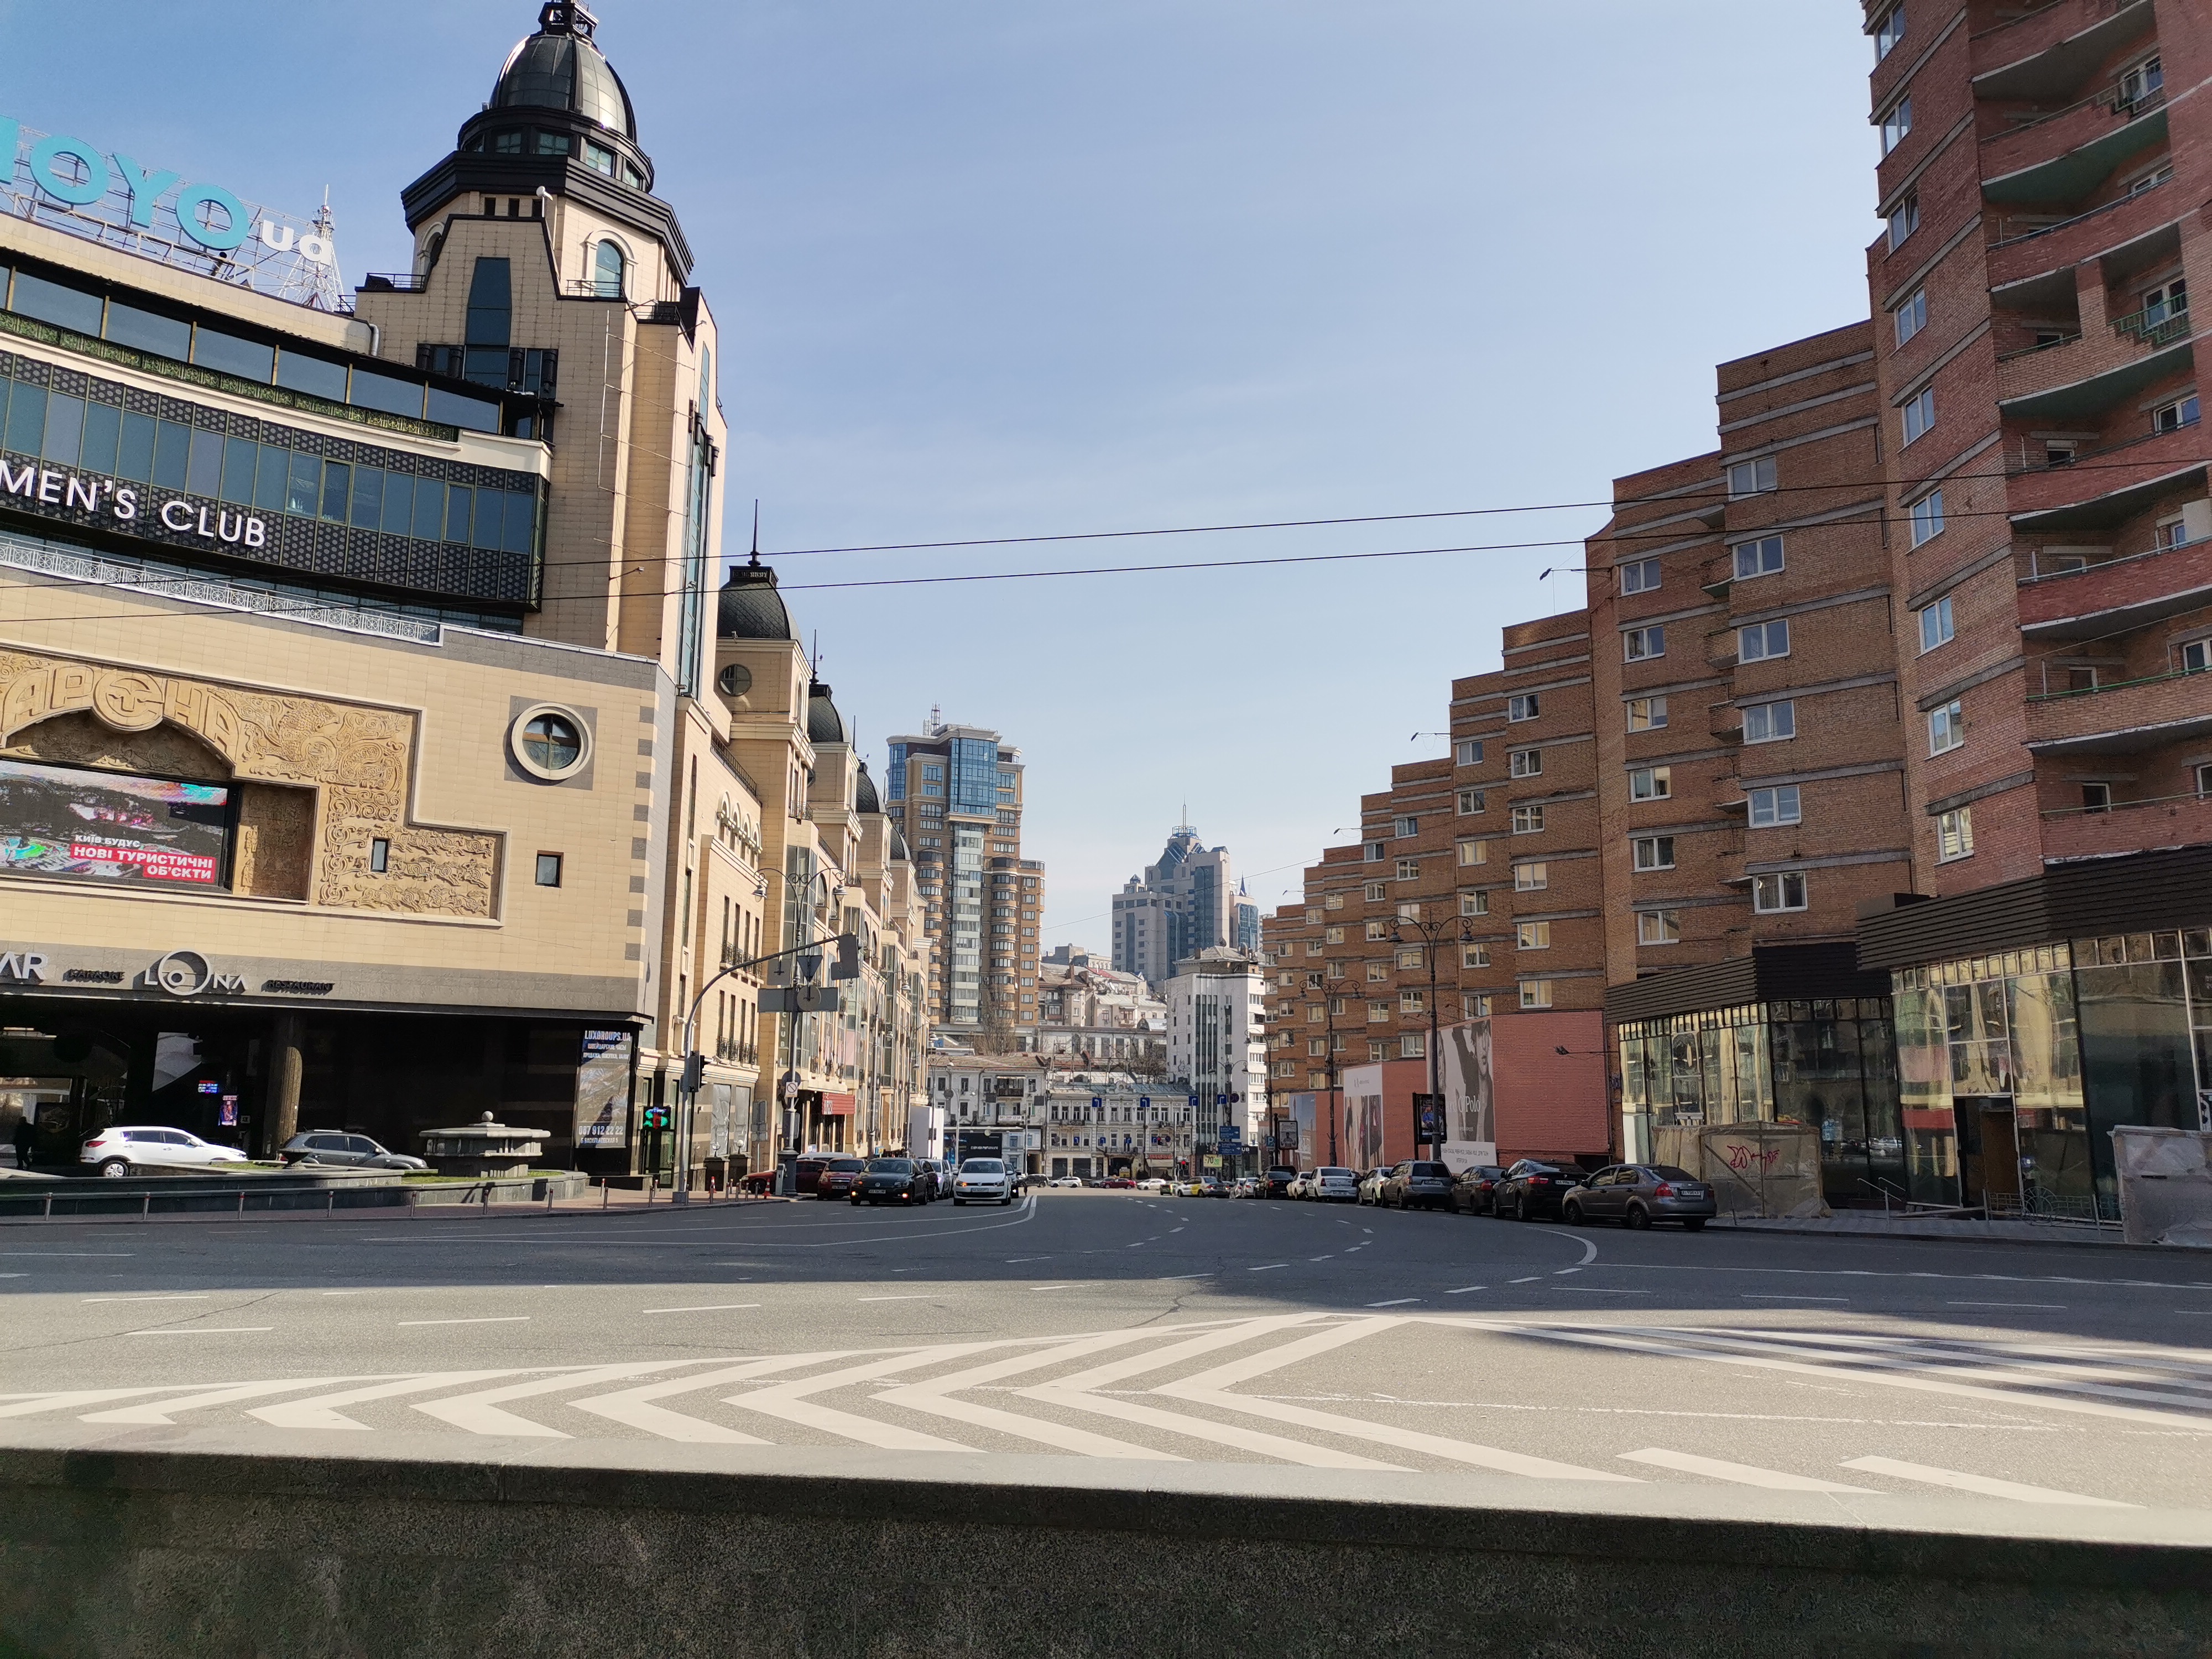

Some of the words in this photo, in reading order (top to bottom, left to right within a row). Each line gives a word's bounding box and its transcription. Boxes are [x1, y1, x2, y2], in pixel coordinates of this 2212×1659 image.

[0, 114, 249, 251] OYO
[161, 500, 265, 547] CLUB
[75, 834, 101, 844] КИЇВ
[104, 838, 141, 848] БУДУЄ
[74, 846, 112, 859] НОВІ
[117, 850, 213, 868] ТУРИСТИЧНІ
[147, 865, 212, 879] ОБ'ЄКТИ
[69, 969, 125, 981] KARAOKE
[267, 979, 335, 992] RESTAURANT
[585, 1030, 631, 1041] LUXGROUPS.UA
[592, 1126, 605, 1135] 912
[606, 1126, 615, 1135] 22
[615, 1126, 624, 1135] 22
